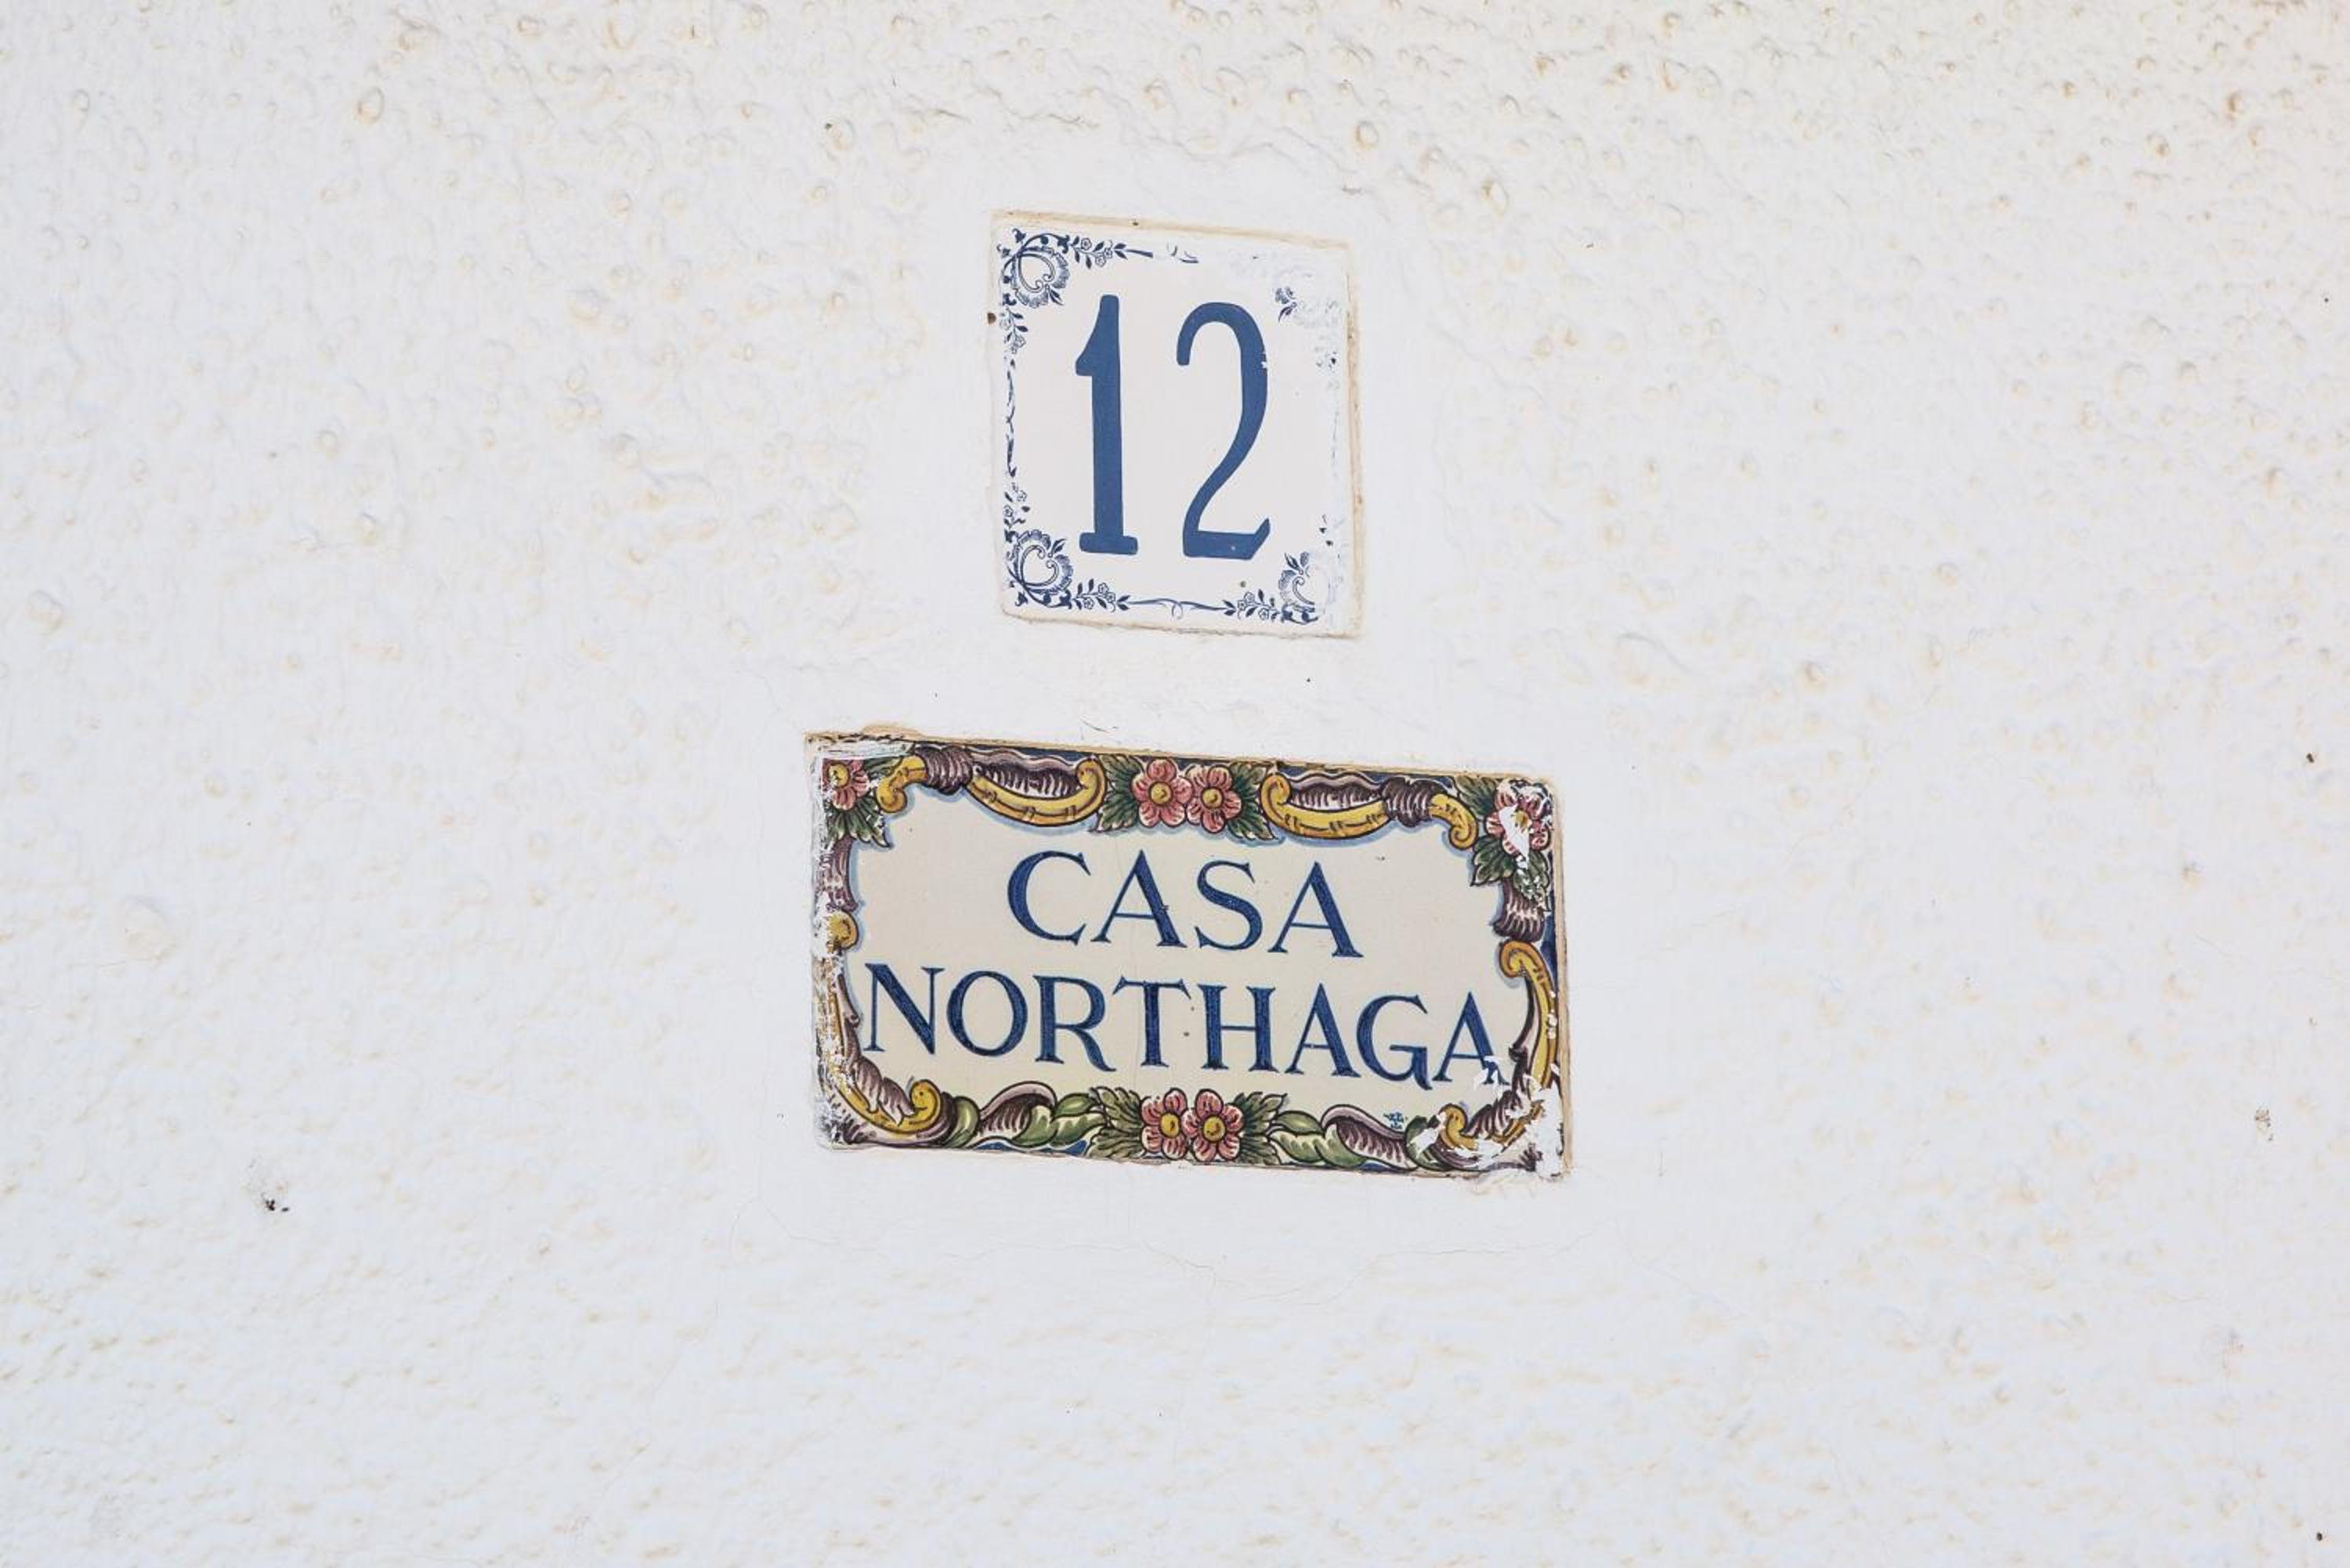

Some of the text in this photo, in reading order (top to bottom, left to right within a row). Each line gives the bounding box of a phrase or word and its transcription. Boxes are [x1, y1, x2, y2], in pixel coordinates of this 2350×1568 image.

[1076, 294, 1271, 560] 12
[1007, 849, 1364, 959] CASA
[864, 963, 1510, 1089] NORTHAGA
